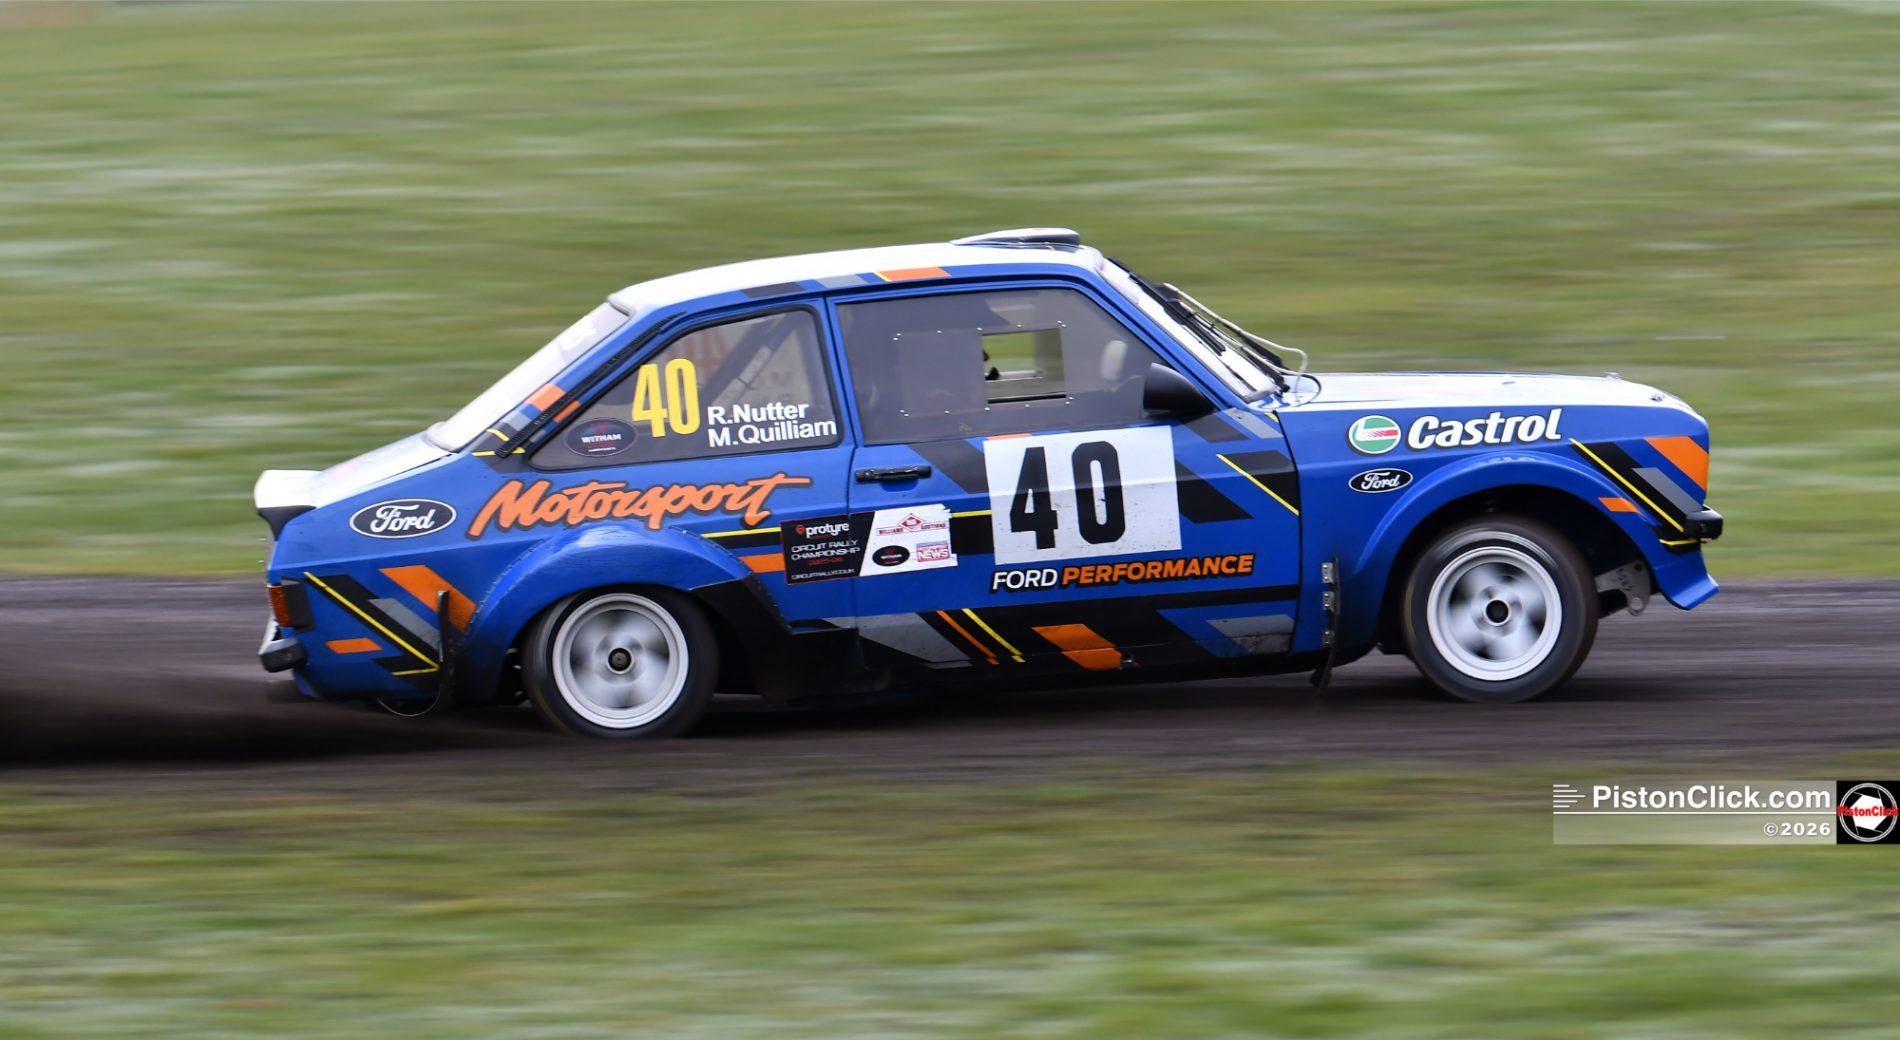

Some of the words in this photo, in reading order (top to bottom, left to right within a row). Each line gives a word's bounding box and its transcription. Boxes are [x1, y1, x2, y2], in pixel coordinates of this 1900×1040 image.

[632, 358, 701, 438] 40
[707, 403, 809, 426] R.Nutter
[1408, 408, 1562, 449] Castrol
[708, 420, 838, 448] M.Quilliam
[1010, 440, 1126, 550] 40
[1360, 471, 1401, 490] Ford
[370, 503, 434, 533] Ford
[467, 473, 811, 538] Motorsport
[806, 523, 850, 539] protyre
[829, 539, 858, 549] RALLY
[918, 548, 949, 559] NEWS
[992, 568, 1058, 590] FORD
[1062, 554, 1255, 585] PERFORMANCE
